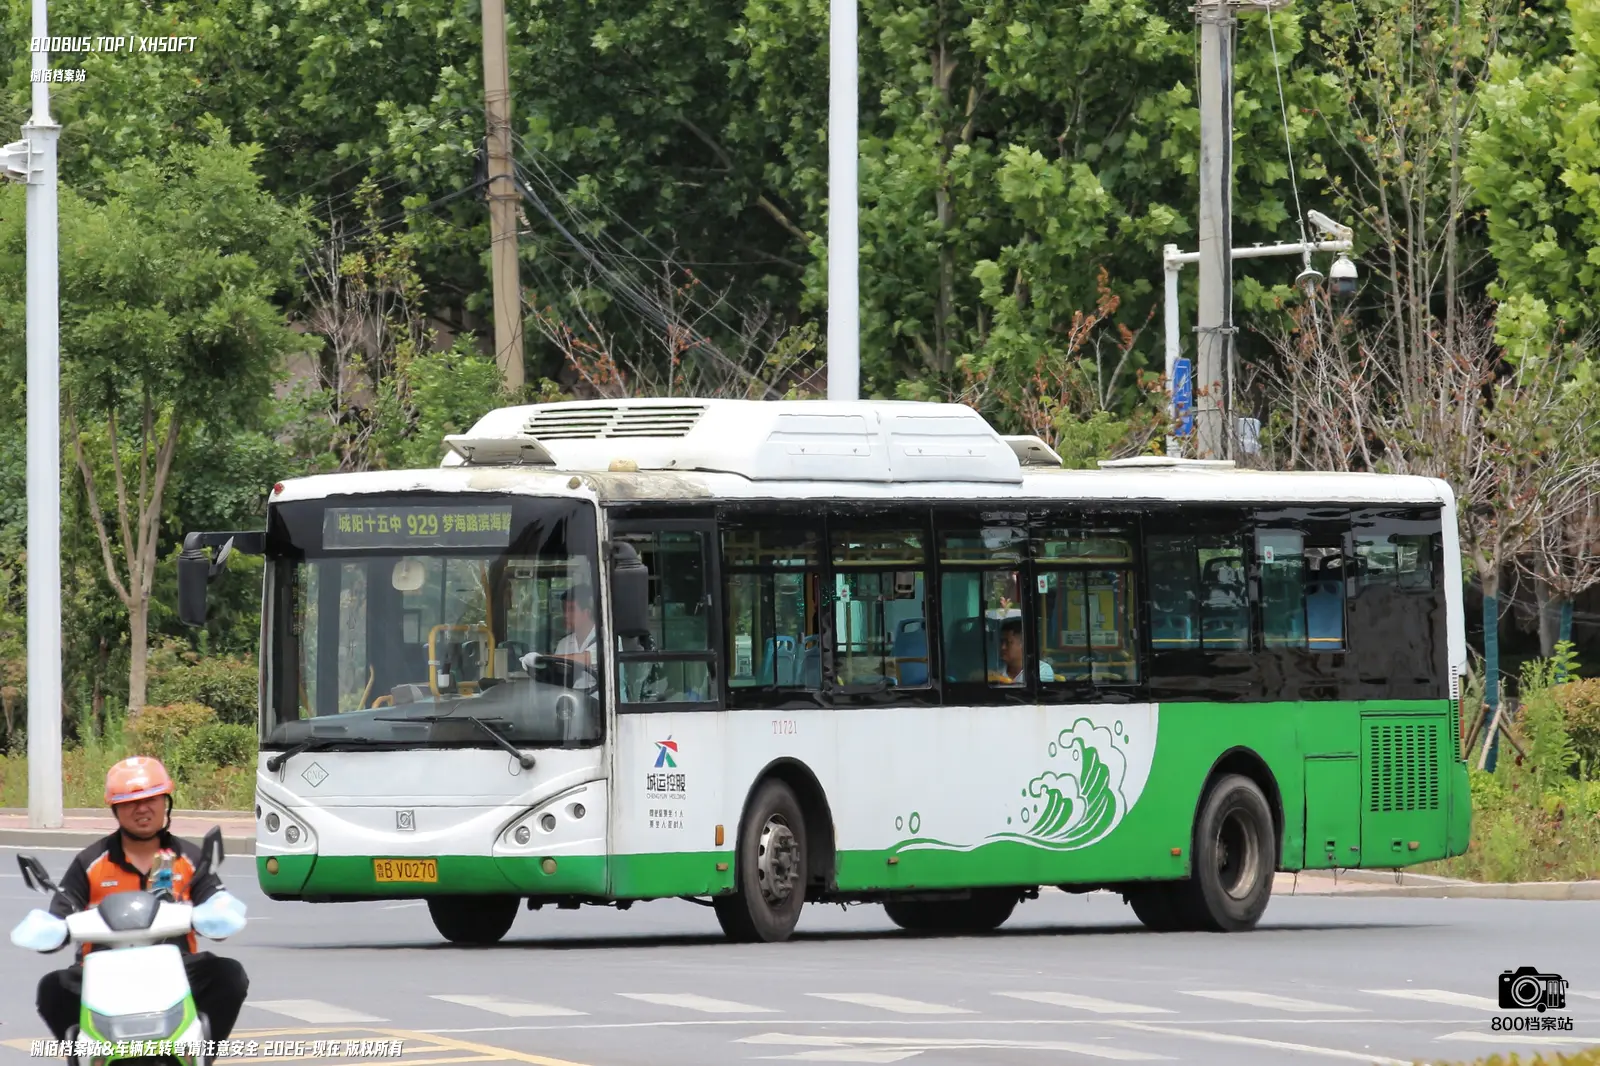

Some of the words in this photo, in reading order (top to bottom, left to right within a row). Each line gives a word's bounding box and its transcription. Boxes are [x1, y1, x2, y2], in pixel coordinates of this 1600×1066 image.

[338, 514, 402, 534] 城阳十五中
[406, 513, 439, 535] 929
[772, 720, 798, 735] T1721
[306, 770, 324, 781] CNG
[646, 773, 686, 792] 城运控股
